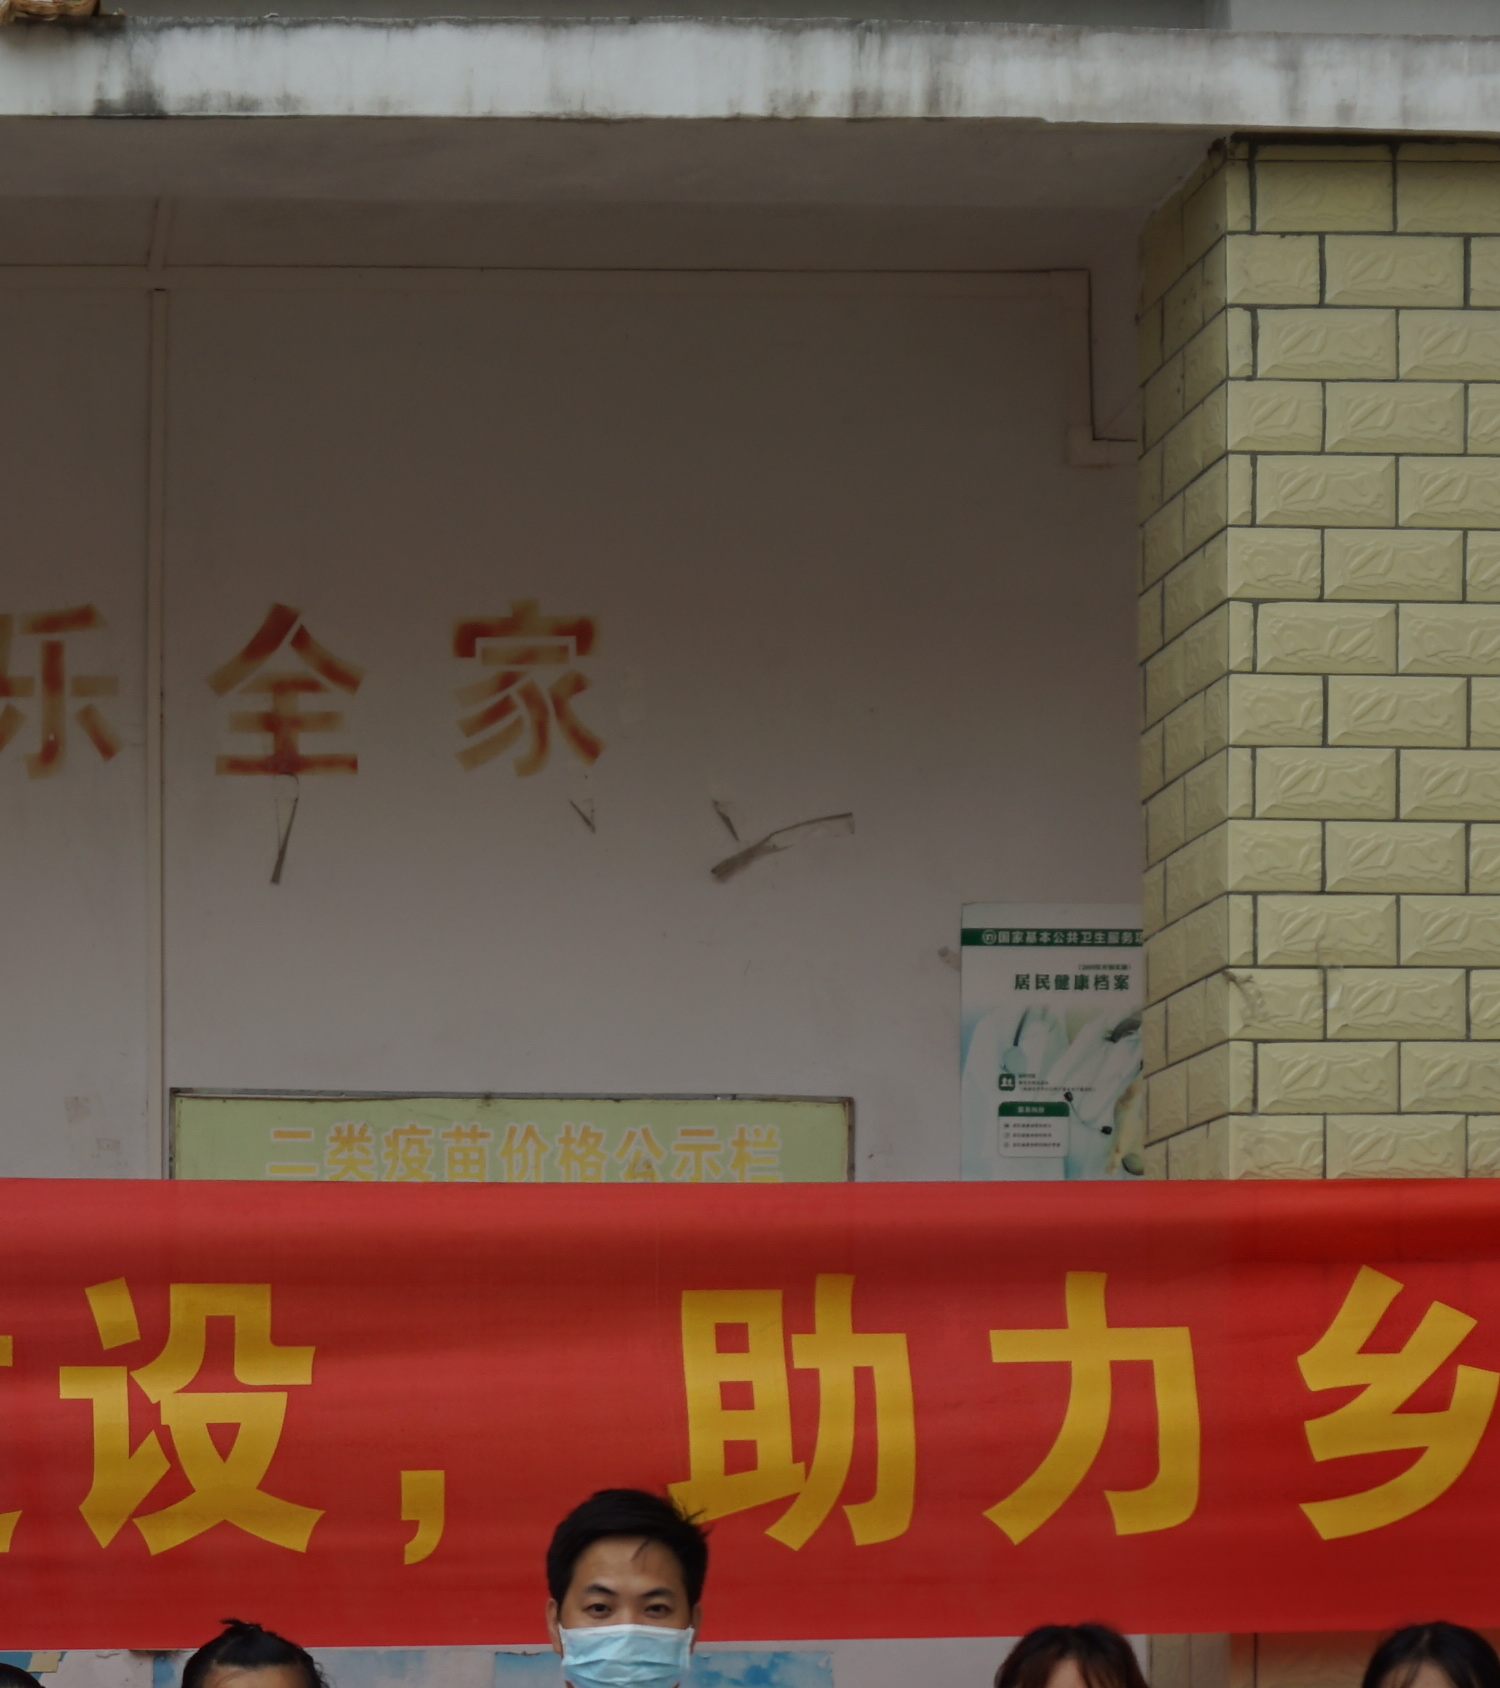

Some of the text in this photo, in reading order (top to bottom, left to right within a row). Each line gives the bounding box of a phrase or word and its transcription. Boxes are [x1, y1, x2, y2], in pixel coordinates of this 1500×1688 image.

[1014, 973, 1130, 991] 居民健康档案
[268, 1122, 784, 1184] 二类疫苗价格公示栏
